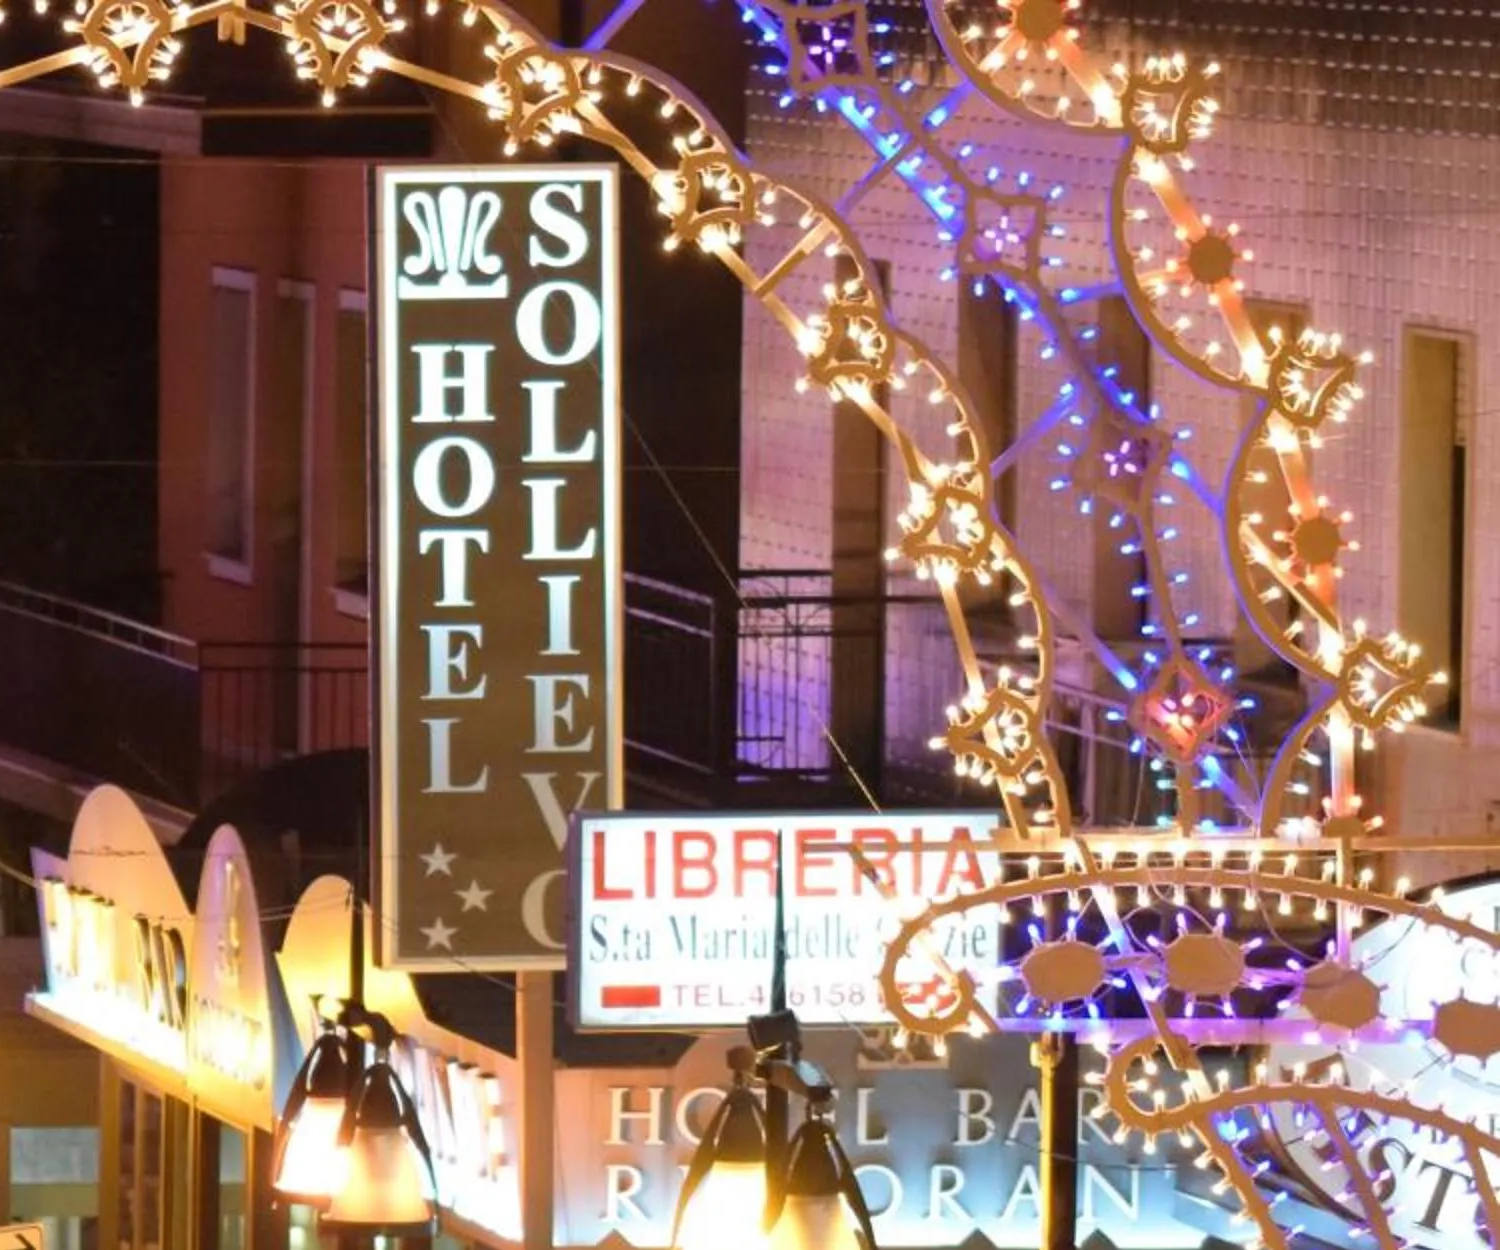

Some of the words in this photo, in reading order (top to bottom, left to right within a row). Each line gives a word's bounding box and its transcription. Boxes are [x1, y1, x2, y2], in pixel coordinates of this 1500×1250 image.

[411, 343, 496, 795] HOTEL
[591, 826, 987, 901] LIBRERIA
[589, 914, 651, 963] S.ta
[604, 1086, 889, 1147] HOL
